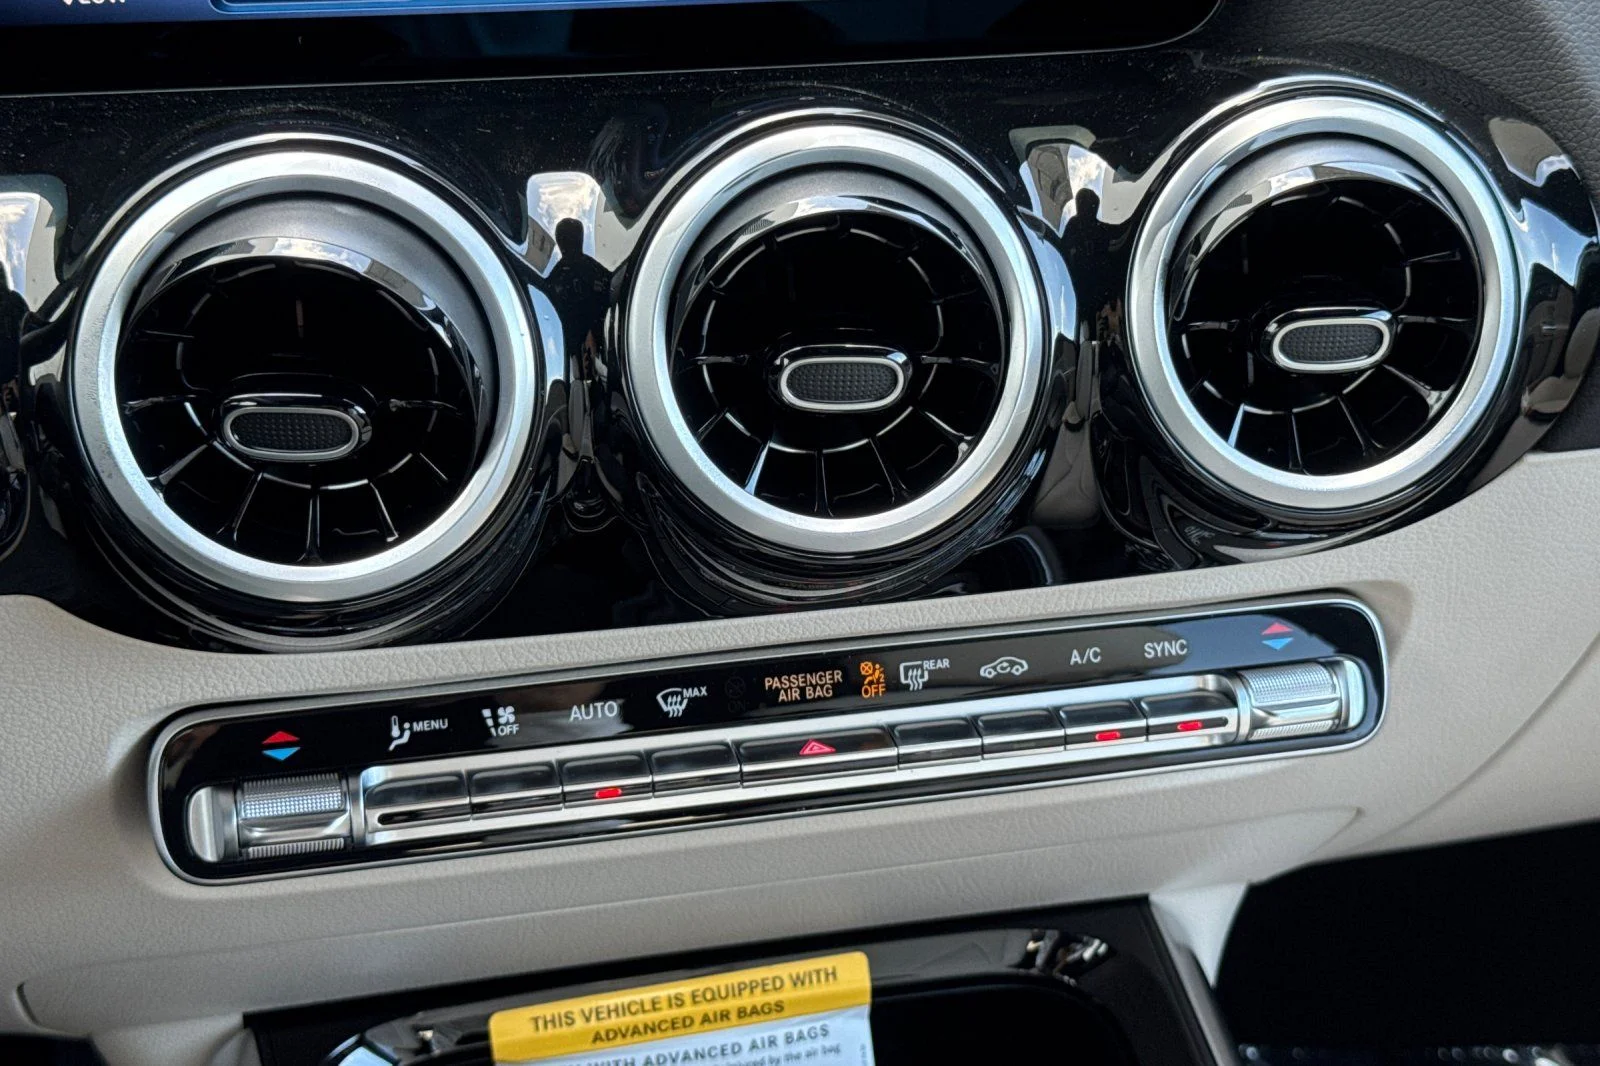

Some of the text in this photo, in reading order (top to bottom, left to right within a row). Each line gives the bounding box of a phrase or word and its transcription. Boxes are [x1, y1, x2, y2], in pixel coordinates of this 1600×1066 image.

[1069, 647, 1101, 666] A/C
[1143, 639, 1188, 659] SYNC
[923, 658, 950, 671] REAR
[764, 669, 843, 691] PASSENGER
[682, 686, 708, 699] MAX
[778, 685, 833, 703] AIR BAG
[861, 683, 886, 699] OFF
[569, 701, 619, 722] AUTO
[412, 718, 449, 733] MENU
[498, 723, 520, 737] OFF
[530, 966, 838, 1033] THIS VEHICLE IS EQUIPPED WITH
[591, 1000, 785, 1044] ADVANCED AIR BAGS
[642, 1041, 743, 1066] ADVANCED
[748, 1034, 779, 1051] AIR
[784, 1024, 830, 1045] BAGS
